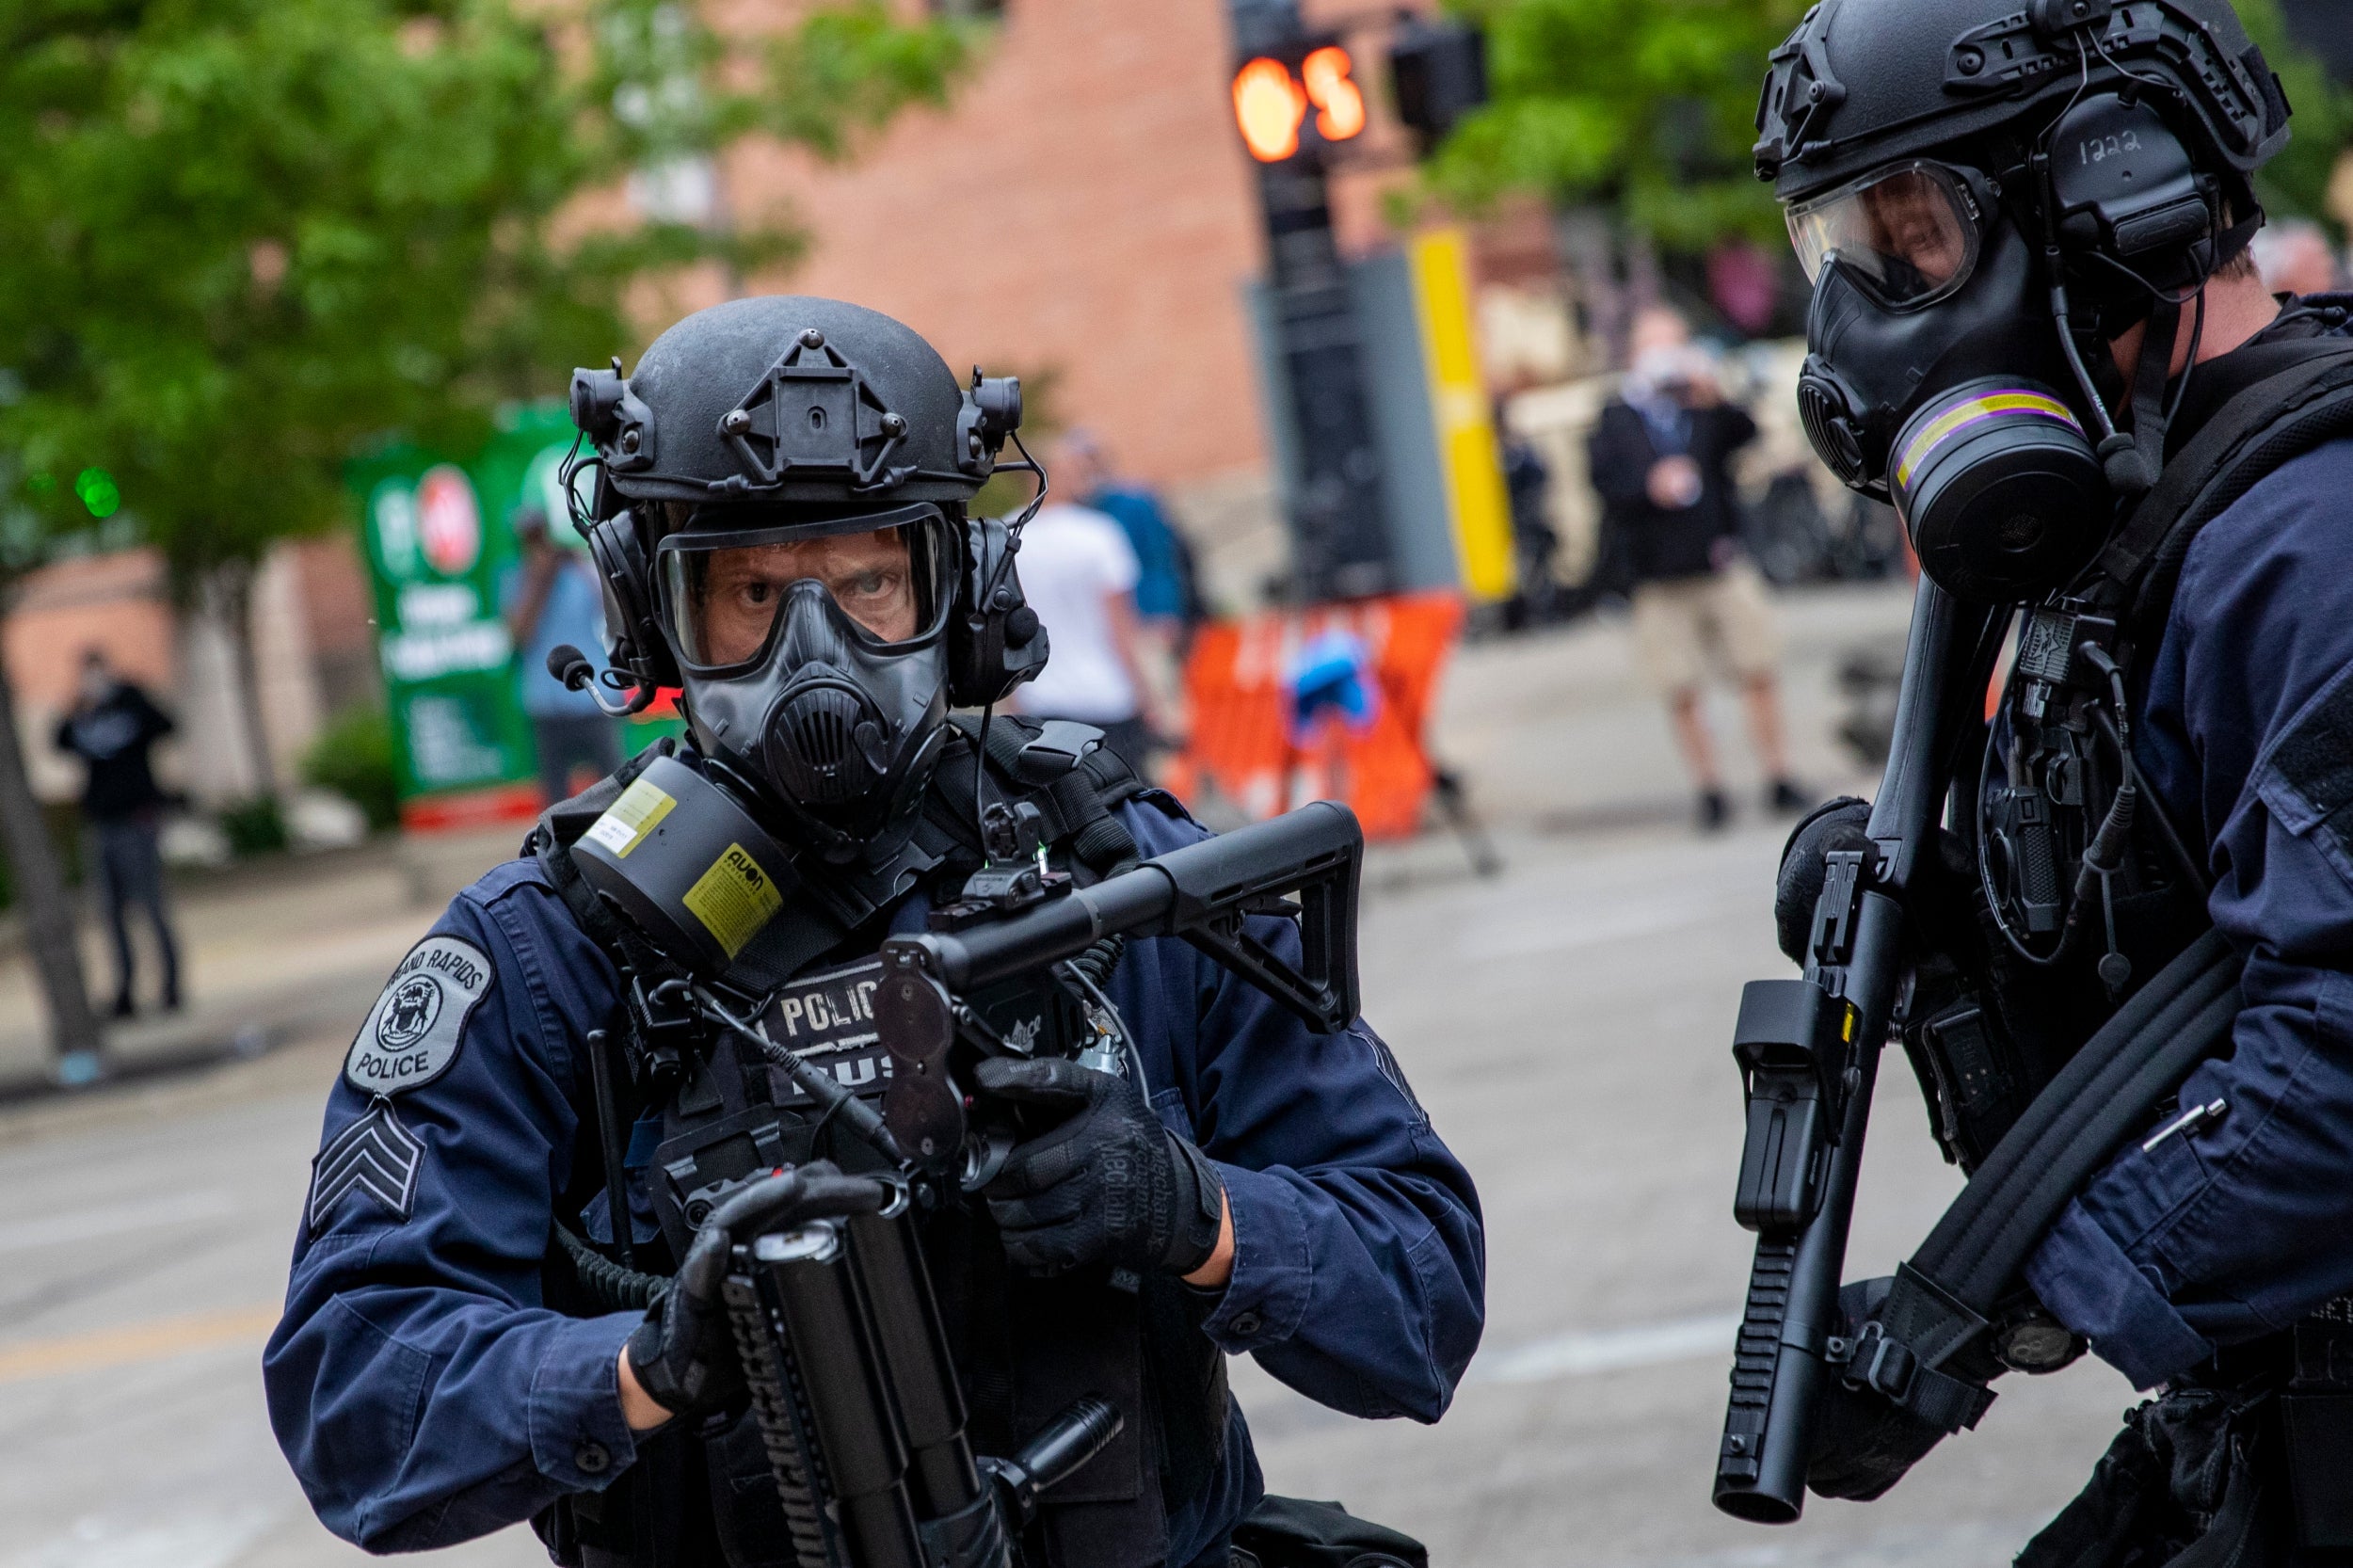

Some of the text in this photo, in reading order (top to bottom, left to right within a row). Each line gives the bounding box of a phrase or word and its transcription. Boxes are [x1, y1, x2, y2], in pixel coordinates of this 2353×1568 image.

[2079, 130, 2142, 165] 1222
[426, 949, 483, 990] RAPIDS
[780, 979, 878, 1036] POLIC
[356, 1050, 429, 1079] POLICE
